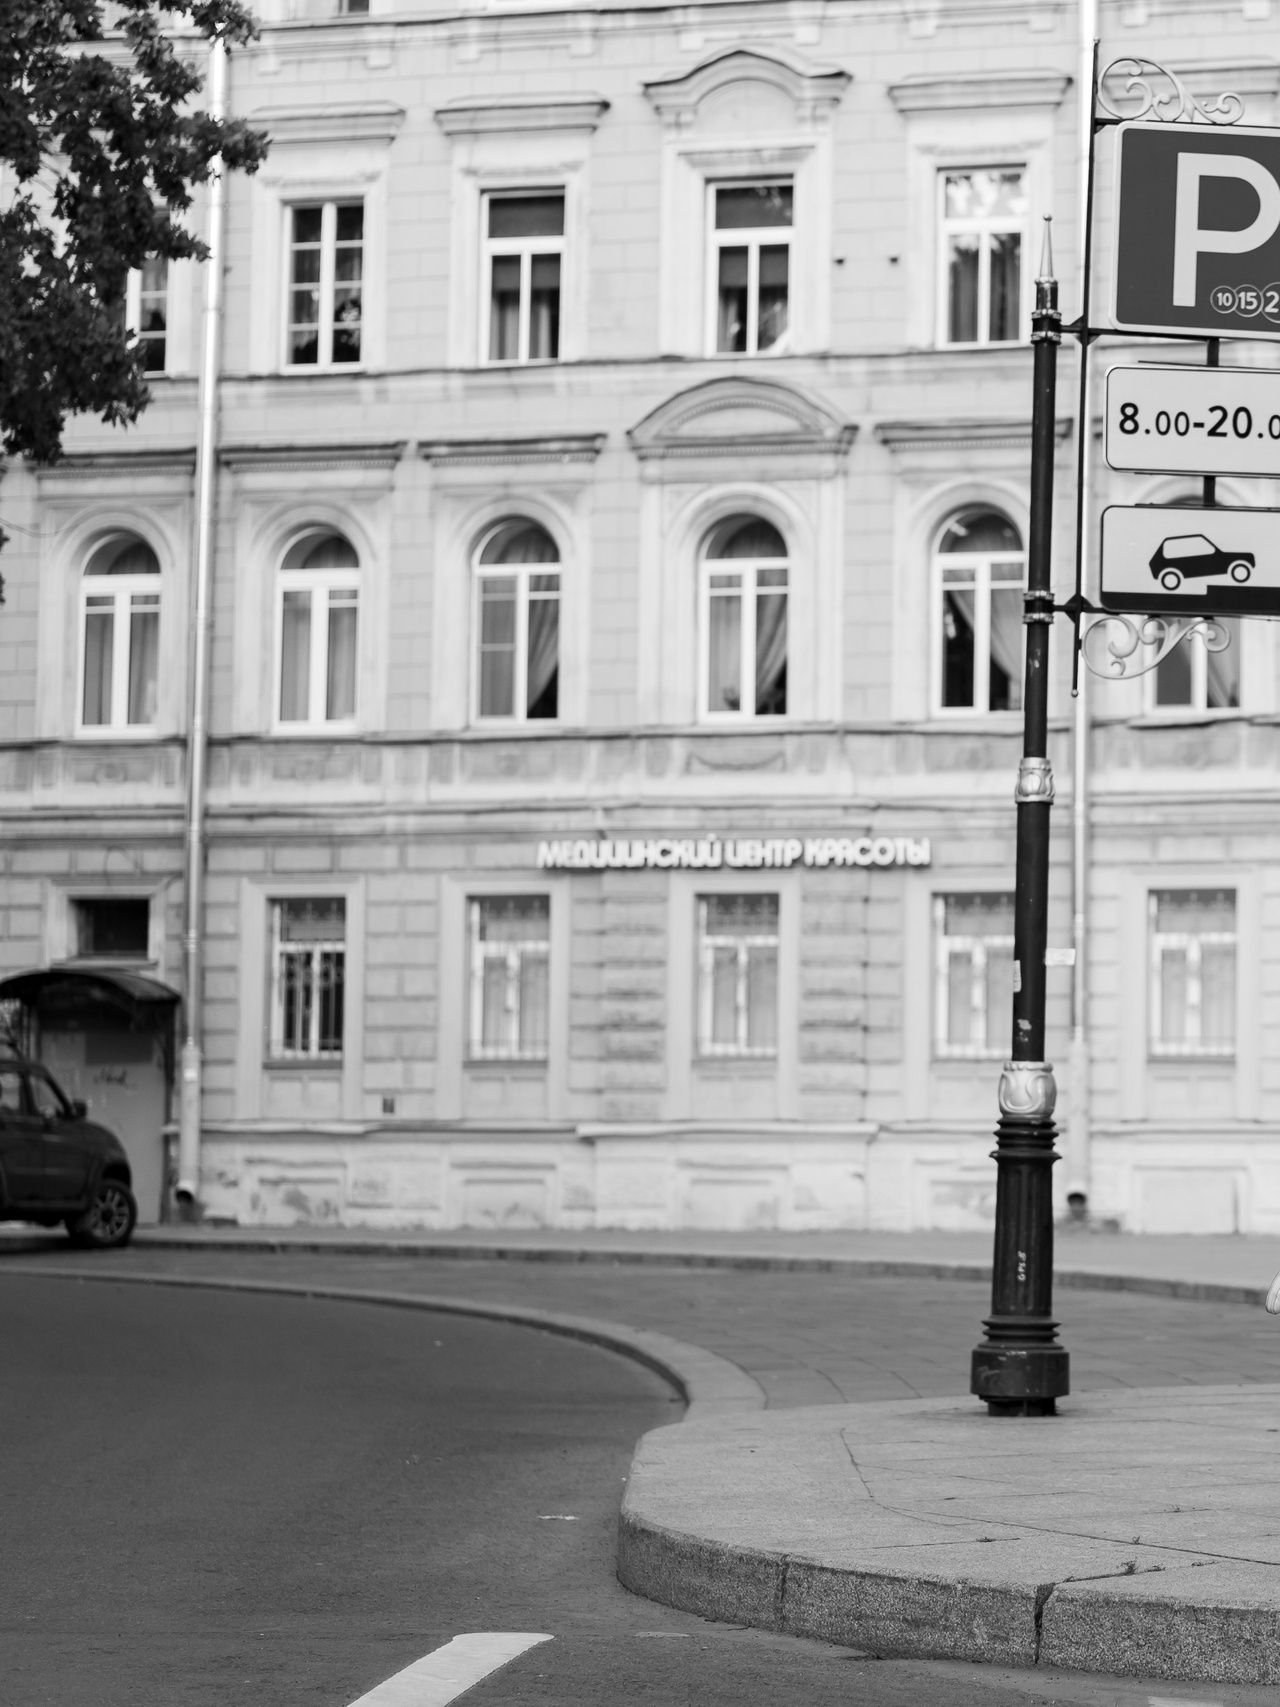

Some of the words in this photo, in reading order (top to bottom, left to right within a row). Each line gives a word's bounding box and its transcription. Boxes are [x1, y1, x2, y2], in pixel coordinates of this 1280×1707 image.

[1216, 292, 1233, 307] 10
[1238, 291, 1258, 310] 15
[536, 832, 723, 869] МЕДИЦИНСКИЙ
[724, 837, 803, 868] ЦЕНТР
[803, 836, 931, 867] КРАСОТЫ
